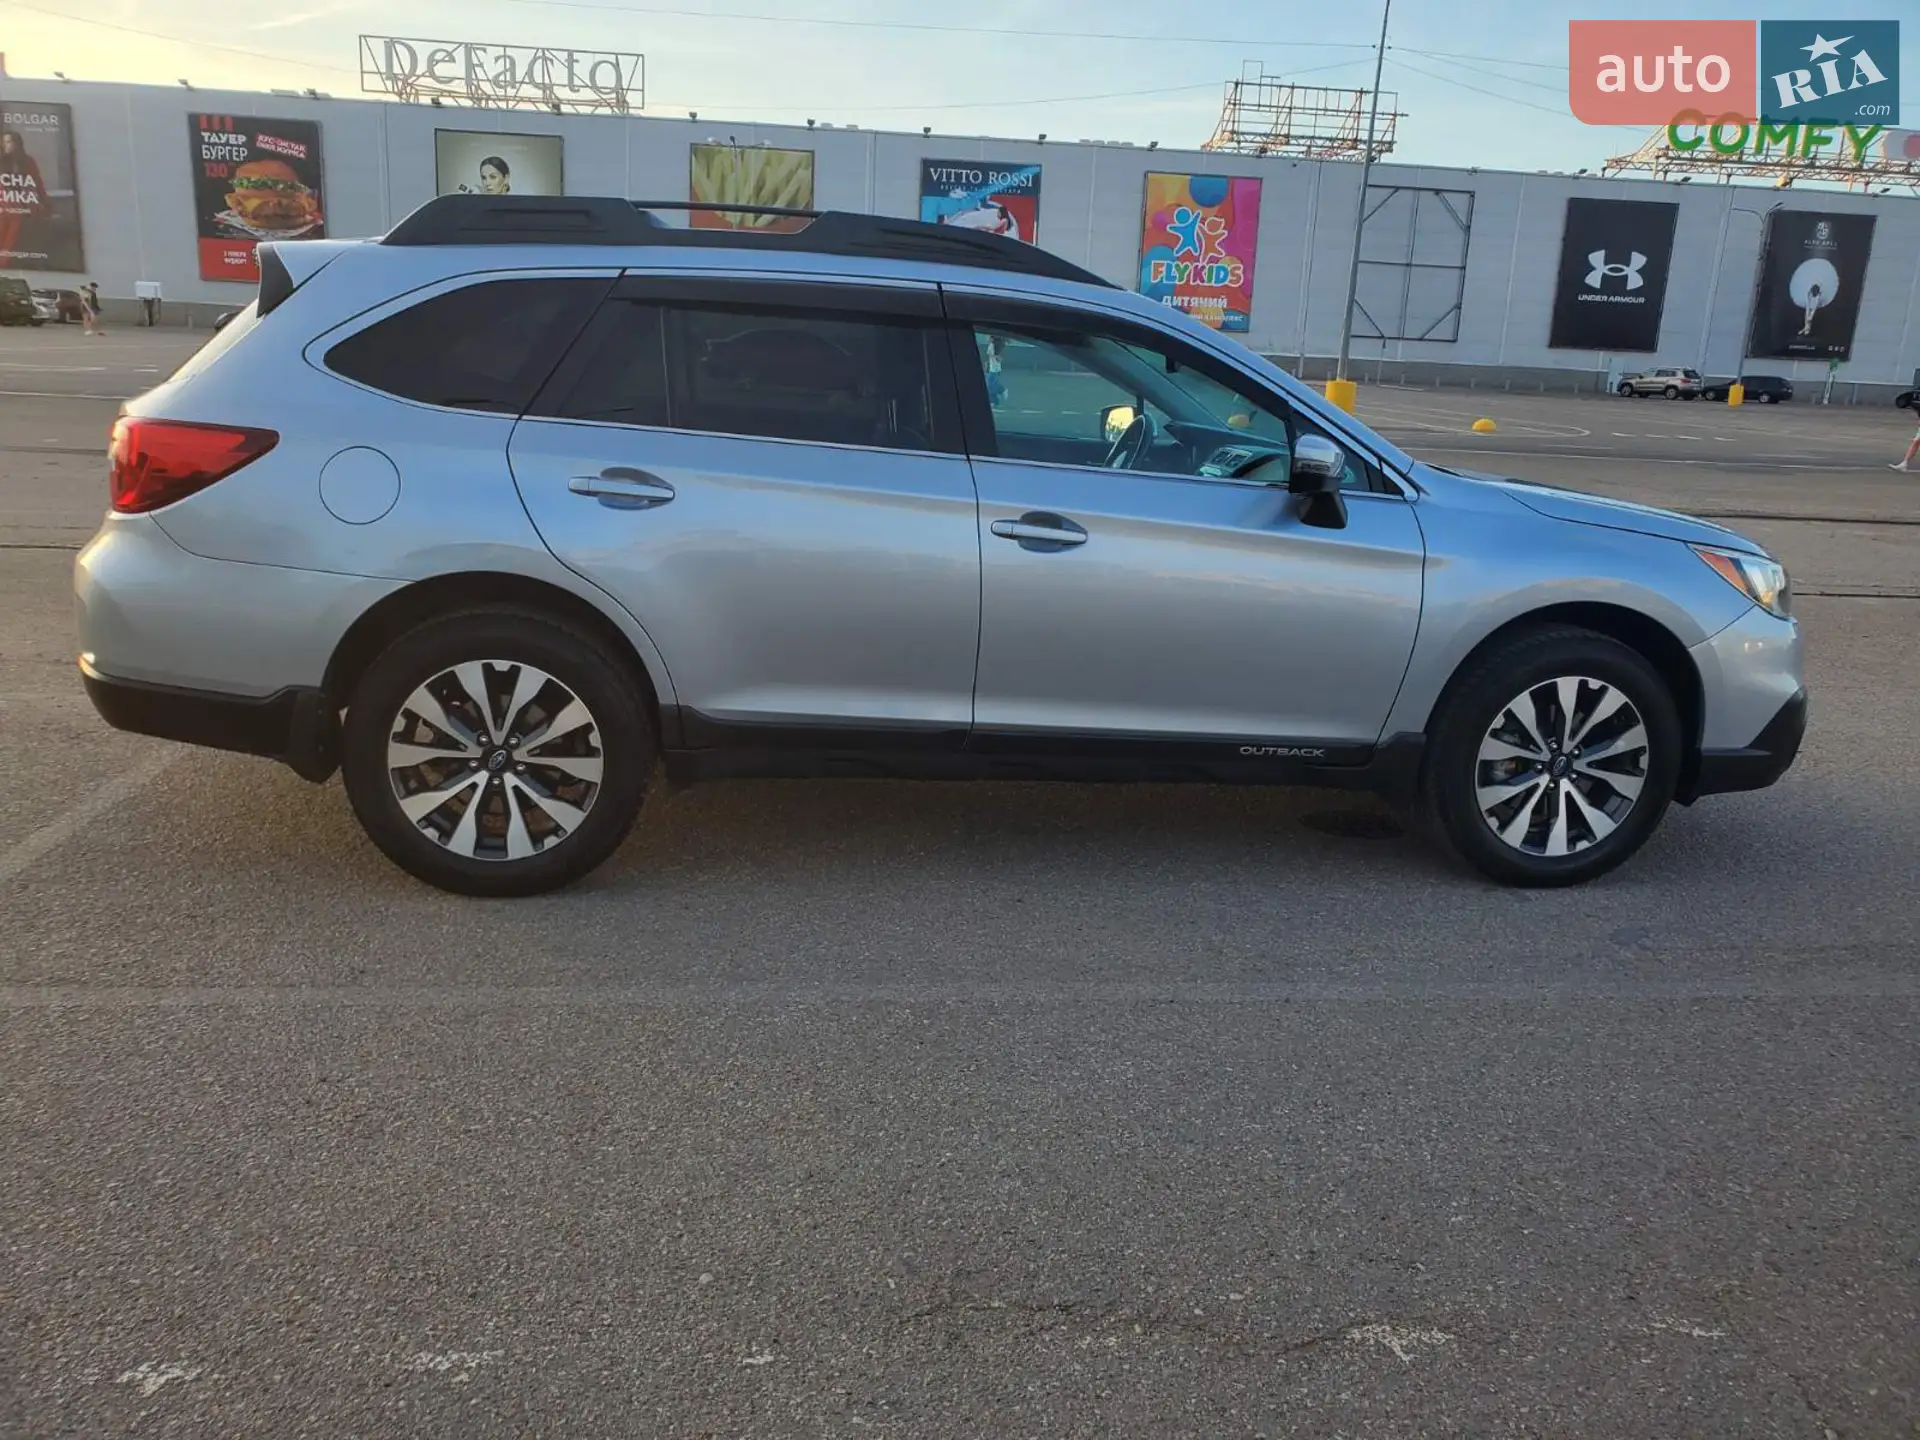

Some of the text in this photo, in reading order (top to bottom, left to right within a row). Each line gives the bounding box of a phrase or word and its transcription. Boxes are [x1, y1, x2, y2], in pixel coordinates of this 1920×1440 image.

[383, 39, 623, 94] DeFacto
[200, 131, 248, 145] ТАУЕР
[1667, 108, 1882, 162] COMFY
[201, 145, 249, 161] БУРГЕР
[929, 167, 1033, 187] VITTO ROSSI
[1162, 295, 1228, 308] ДИТЯЧИЙ
[1577, 293, 1645, 304] UNDER ARMOUR
[1239, 746, 1325, 758] OUTBACK
